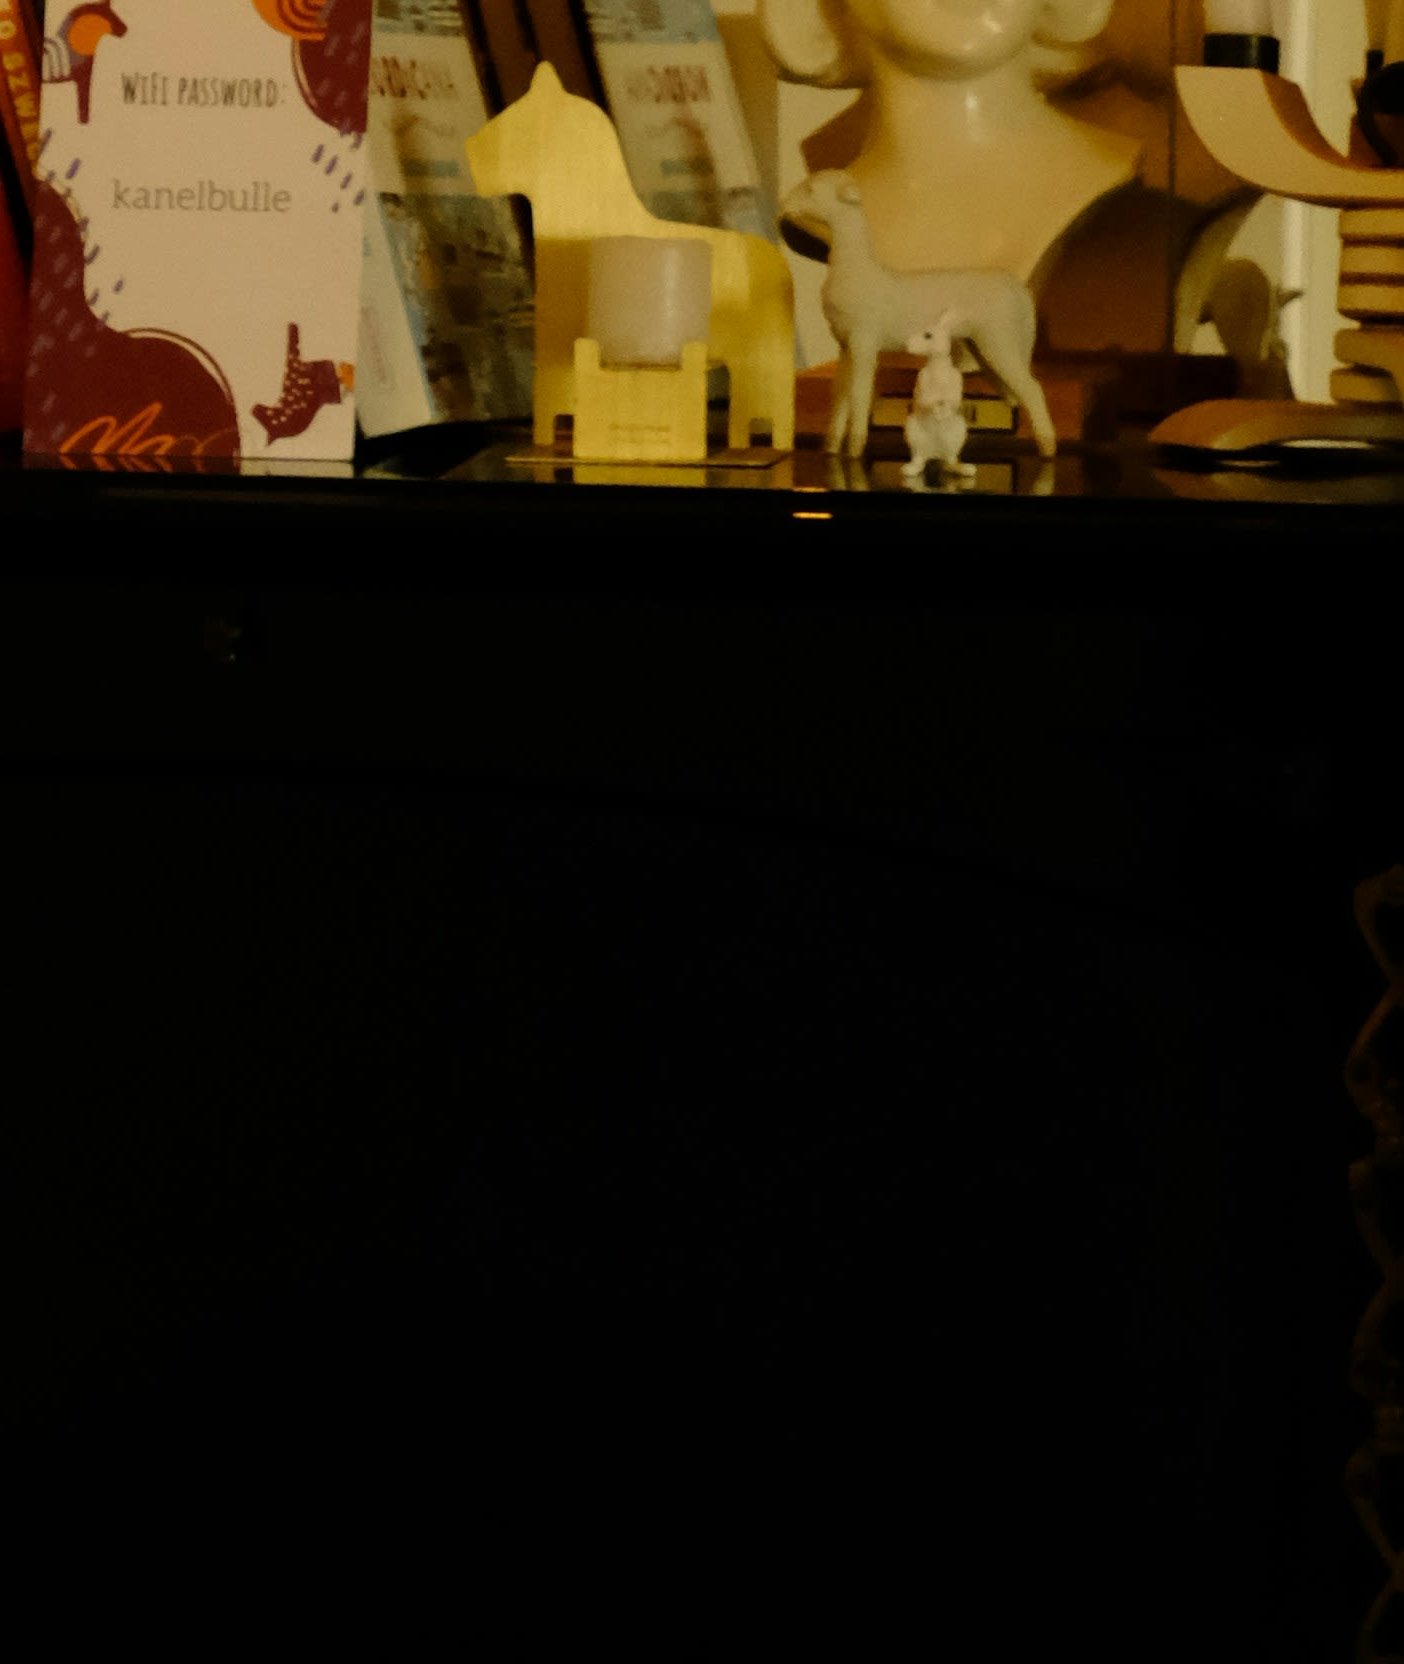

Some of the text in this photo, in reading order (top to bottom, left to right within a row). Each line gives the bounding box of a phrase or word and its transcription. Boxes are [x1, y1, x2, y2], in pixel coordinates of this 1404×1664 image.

[120, 72, 287, 108] WIFI PASSWORD:
[112, 178, 292, 213] kanelbulle
